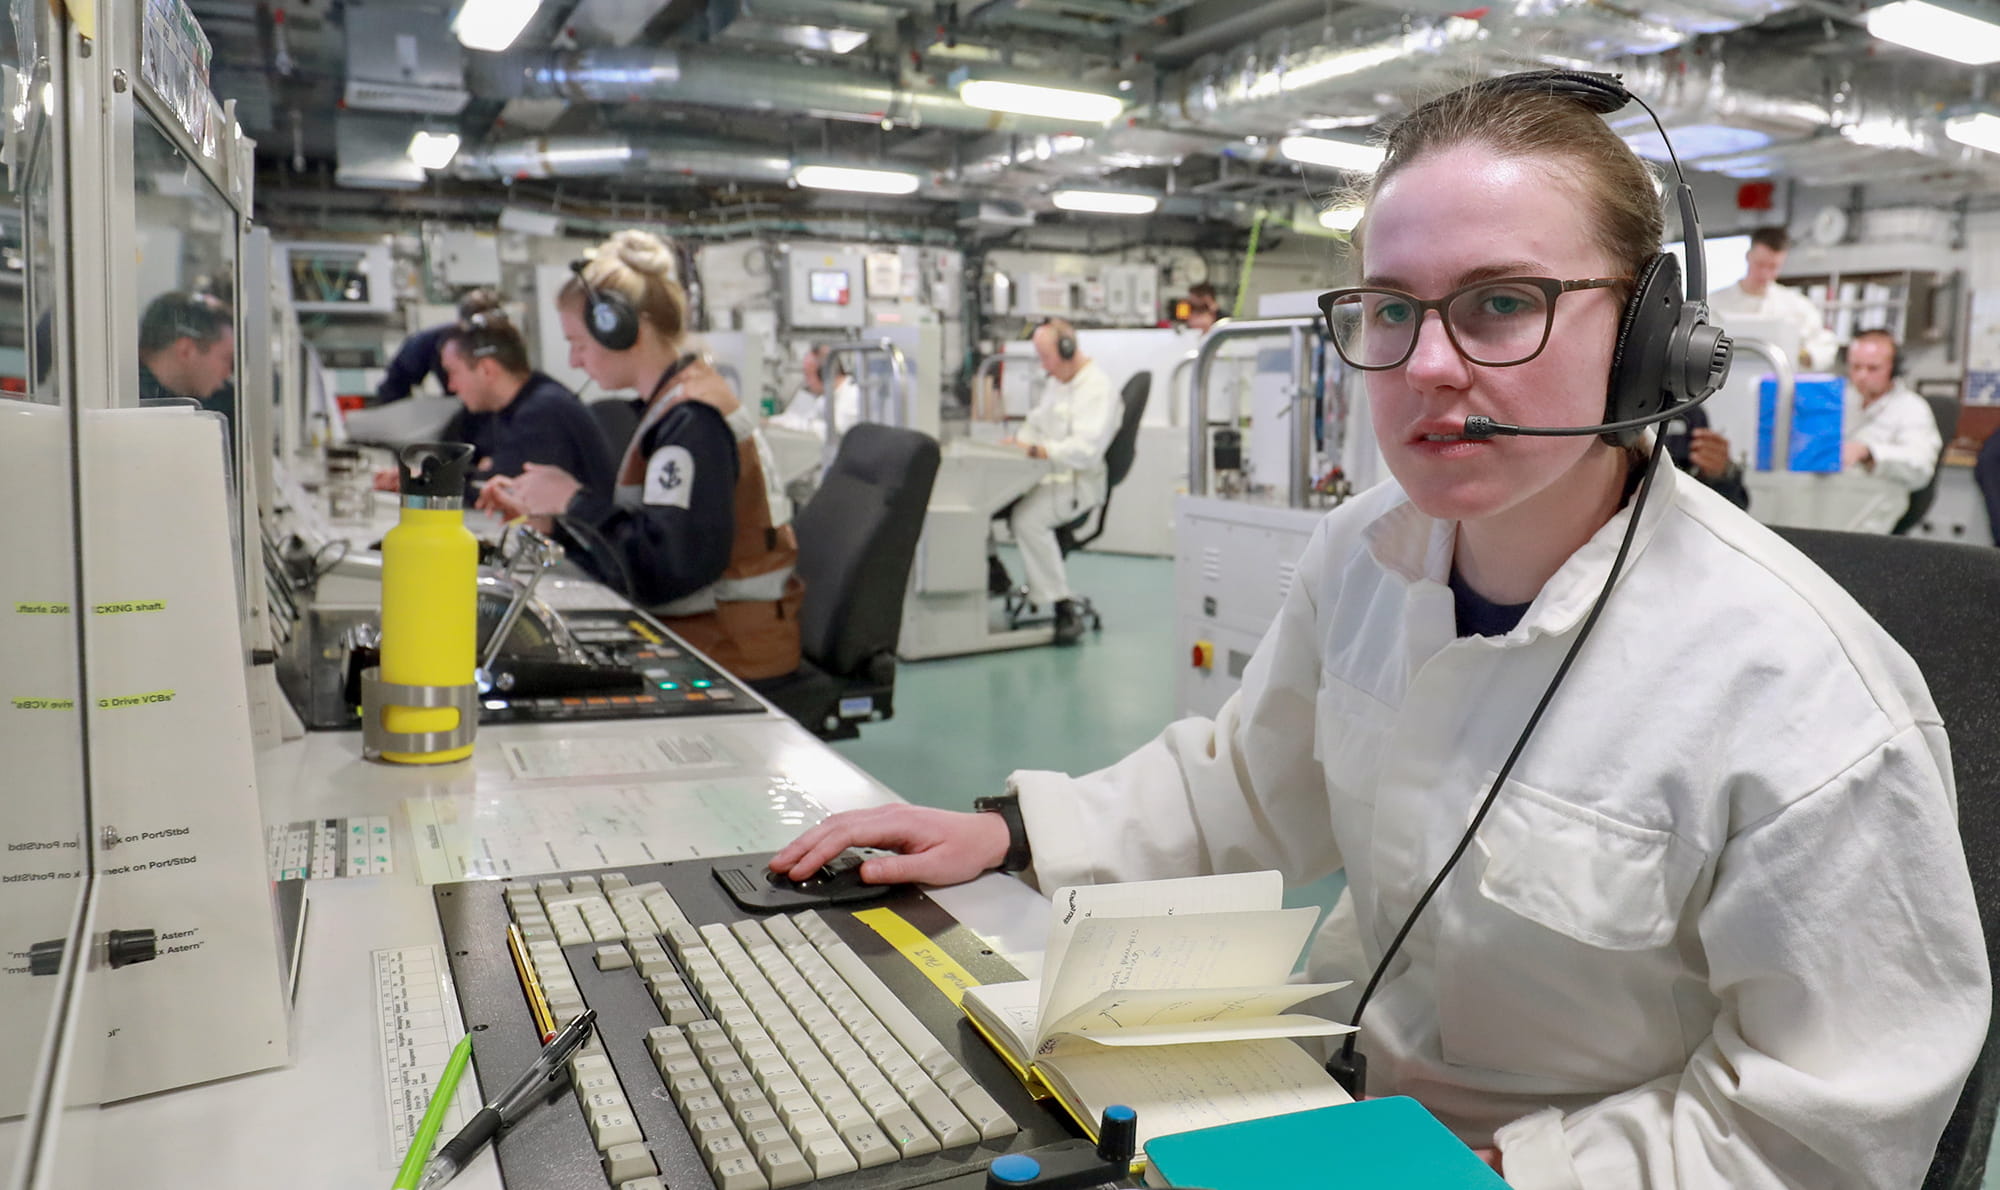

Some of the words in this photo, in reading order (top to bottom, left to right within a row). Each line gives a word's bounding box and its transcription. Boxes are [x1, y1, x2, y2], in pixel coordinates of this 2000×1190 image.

[94, 604, 133, 614] CKING
[112, 698, 140, 706] Drive
[141, 827, 190, 840] Port/Stbd
[133, 864, 146, 872] on
[149, 856, 196, 869] Port/Stbd
